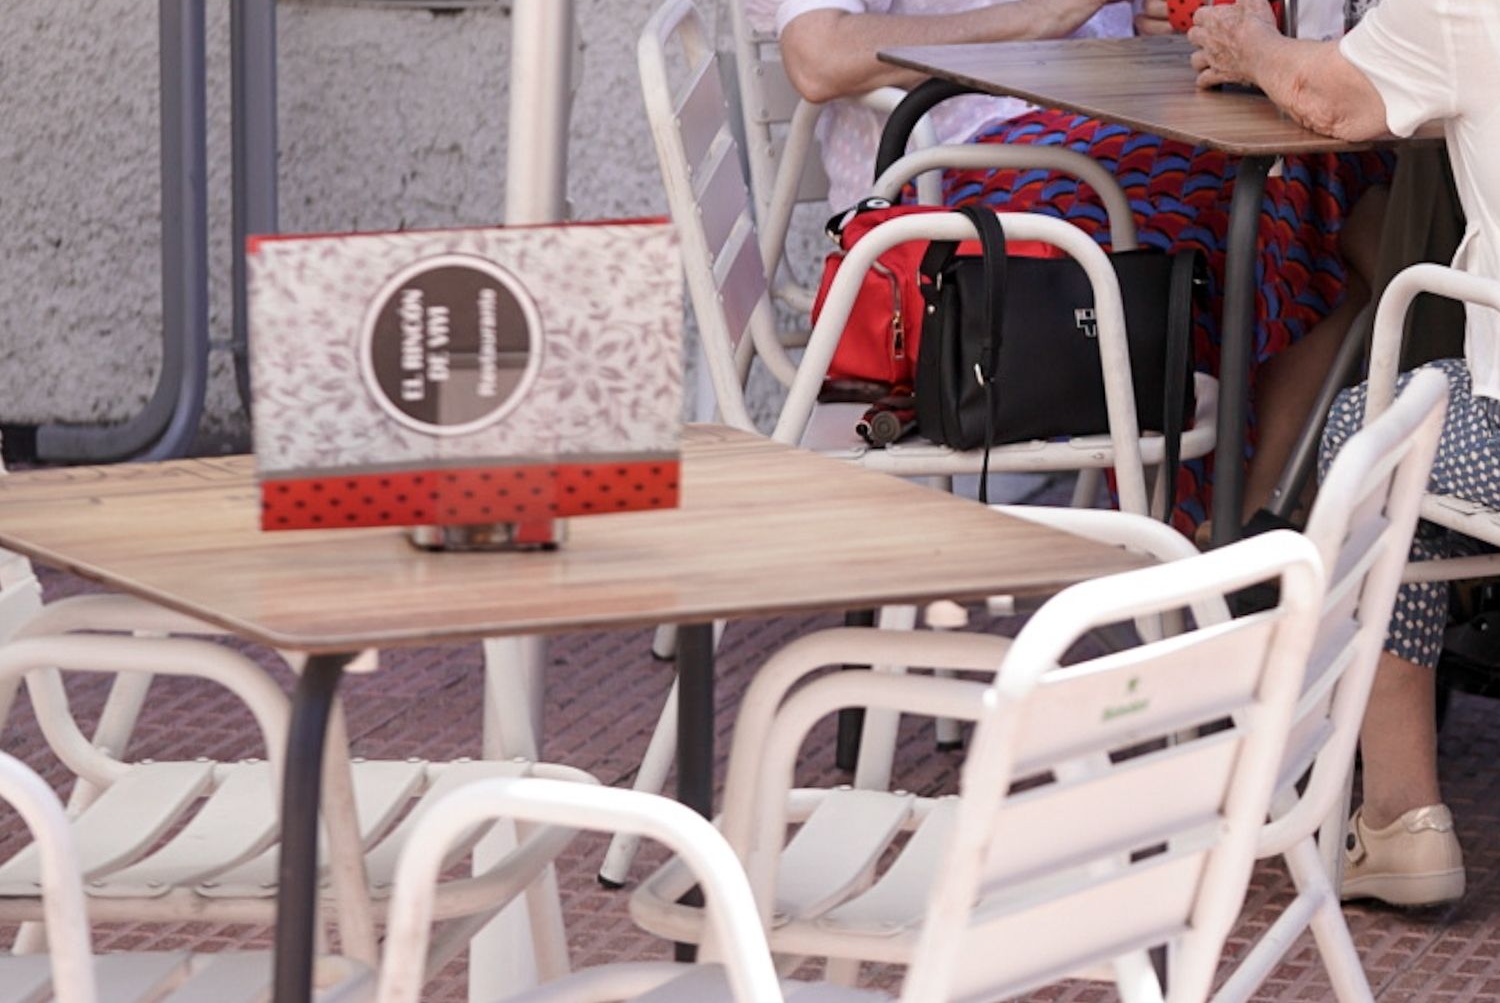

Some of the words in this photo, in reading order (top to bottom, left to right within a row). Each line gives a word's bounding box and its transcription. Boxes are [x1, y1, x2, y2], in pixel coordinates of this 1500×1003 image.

[478, 288, 498, 397] Restaurante
[426, 351, 450, 382] DE
[401, 372, 424, 401] EL
